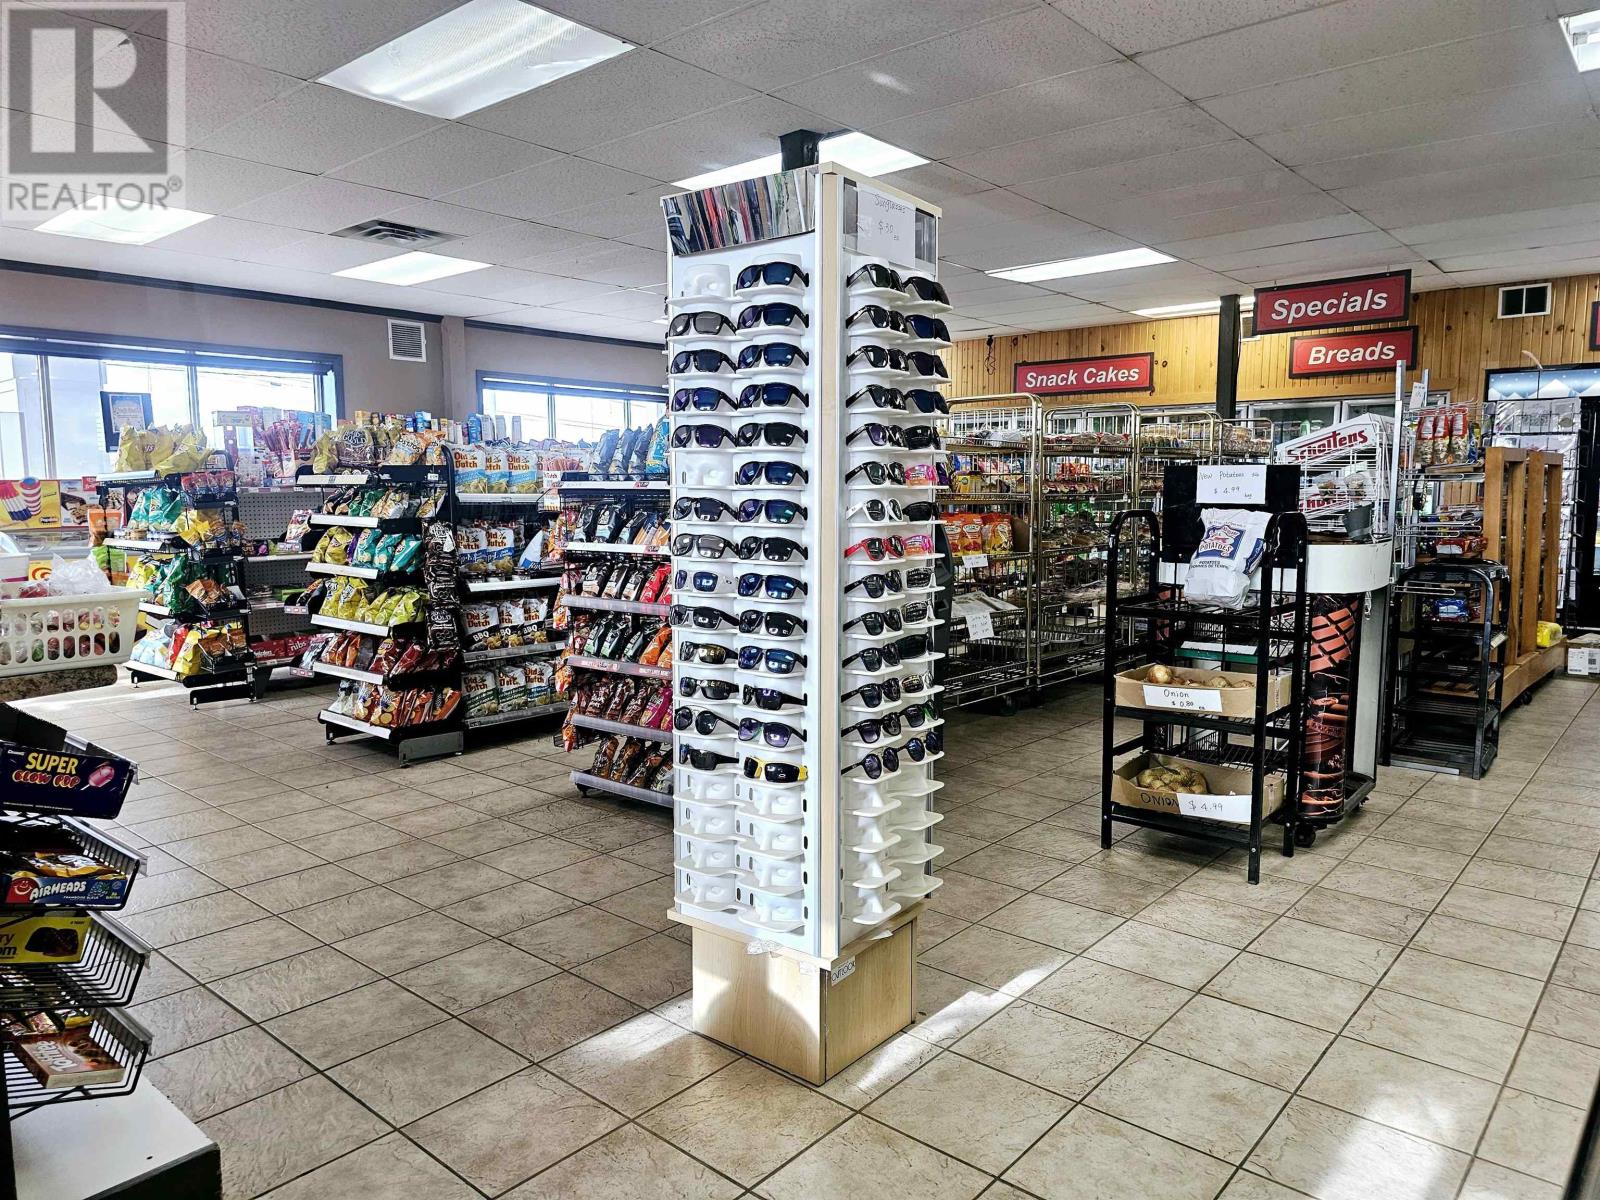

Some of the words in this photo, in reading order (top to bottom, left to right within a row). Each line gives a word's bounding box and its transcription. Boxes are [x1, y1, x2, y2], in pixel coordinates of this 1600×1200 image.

[1271, 288, 1389, 324] Specials
[1308, 341, 1397, 366] Breads
[1025, 369, 1078, 388] Snack
[1083, 366, 1140, 385] Cakes
[454, 451, 468, 461] Old
[507, 454, 521, 463] Old
[455, 459, 478, 469] Dutch
[508, 462, 530, 471] Dutch
[1199, 541, 1233, 553] POTATOES
[466, 612, 480, 620] Old
[467, 620, 490, 628] Dutch
[522, 624, 538, 634] BBQ
[472, 630, 490, 642] BBQ
[500, 627, 511, 636] BQ
[290, 641, 307, 651] nibs
[1163, 688, 1190, 698] Onion
[25, 752, 79, 775] SUPER
[12, 769, 52, 785] BLOW
[53, 774, 81, 789] POP
[1200, 800, 1223, 811] 4.99
[29, 881, 87, 901] AIRHEADS
